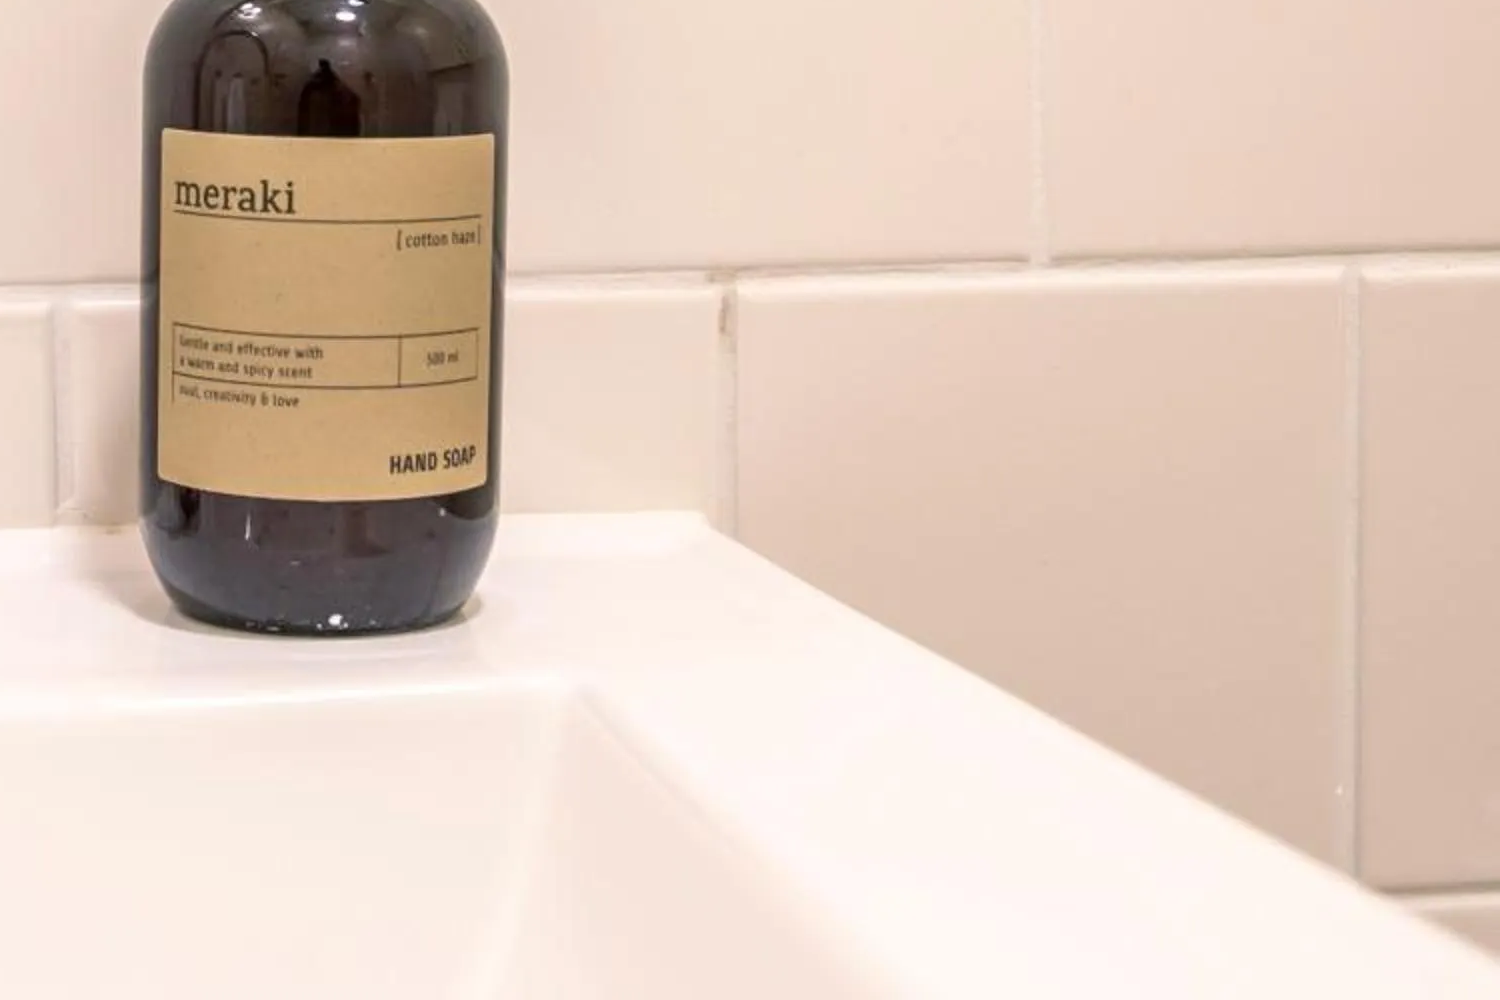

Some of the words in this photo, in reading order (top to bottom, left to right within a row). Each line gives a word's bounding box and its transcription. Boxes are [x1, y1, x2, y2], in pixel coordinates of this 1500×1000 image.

[174, 180, 296, 214] meraki
[212, 340, 233, 354] and
[236, 343, 290, 358] effective
[294, 347, 324, 359] with
[187, 357, 215, 371] warm
[218, 361, 238, 374] and
[243, 364, 274, 380] spicy
[278, 366, 313, 378] scent
[203, 389, 256, 407] creativity
[273, 392, 299, 407] love
[389, 452, 438, 475] HAND
[442, 445, 477, 470] SOAP
